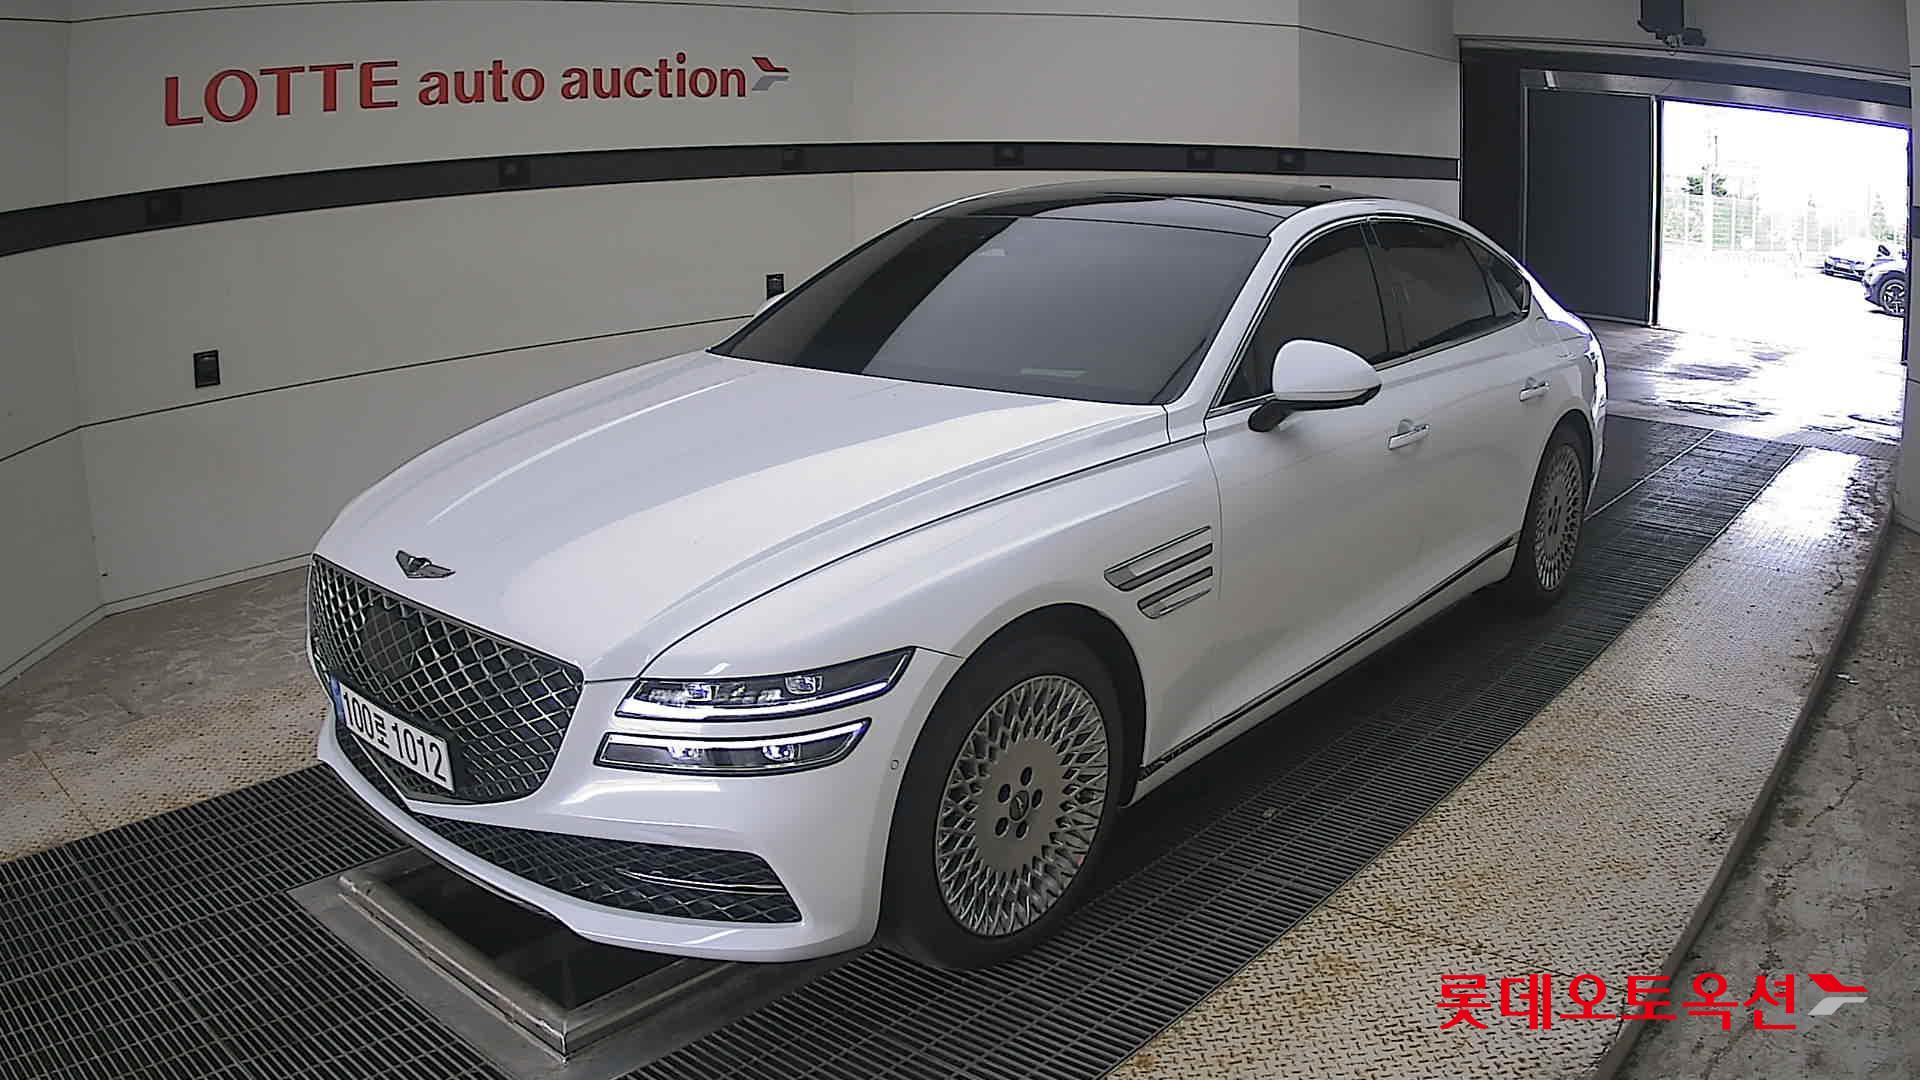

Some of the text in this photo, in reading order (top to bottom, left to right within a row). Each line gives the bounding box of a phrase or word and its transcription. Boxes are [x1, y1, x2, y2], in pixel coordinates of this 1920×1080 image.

[164, 51, 747, 126] LOTTE auto auction
[343, 692, 447, 782] 100로 1012
